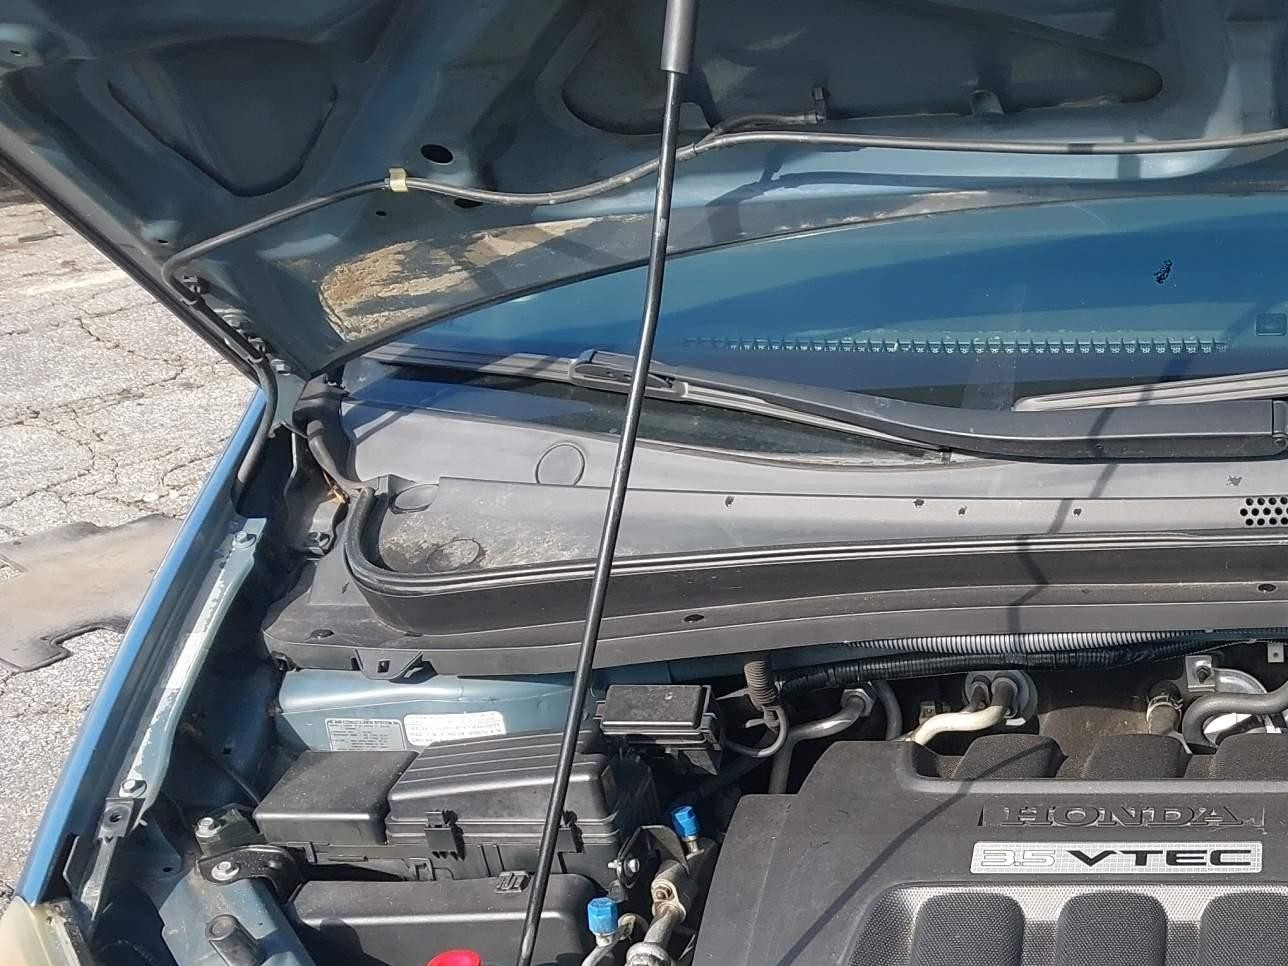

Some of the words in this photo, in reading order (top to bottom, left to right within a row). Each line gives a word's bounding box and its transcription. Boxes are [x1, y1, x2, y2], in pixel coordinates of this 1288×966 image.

[1000, 806, 1244, 828] HONDA
[981, 849, 1056, 867] 3.5
[1066, 849, 1252, 867] VTEC
